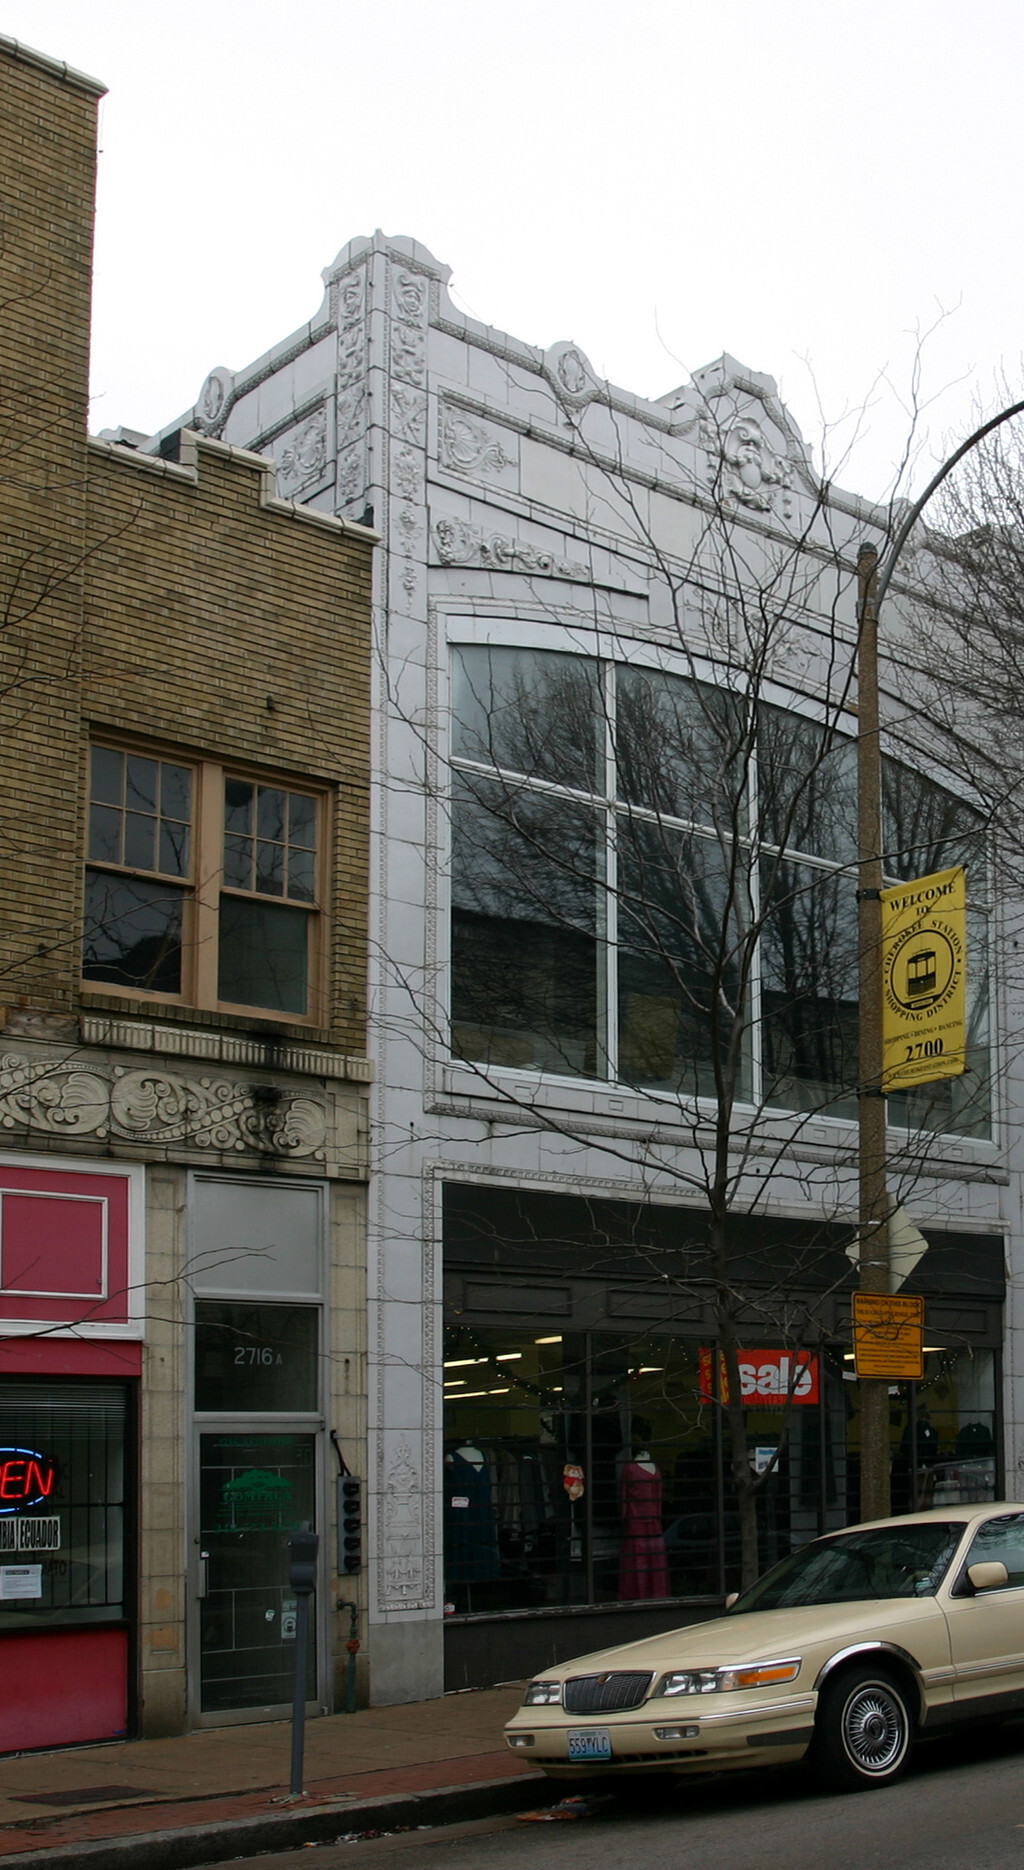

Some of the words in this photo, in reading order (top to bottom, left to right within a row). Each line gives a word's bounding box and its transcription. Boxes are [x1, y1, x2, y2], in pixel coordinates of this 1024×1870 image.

[889, 881, 956, 911] WELCOME
[916, 905, 929, 916] TO
[930, 919, 962, 954] STATION
[884, 988, 923, 1021] SHOPPING
[926, 971, 962, 1018] DISTRICT
[904, 1037, 944, 1061] 2700
[234, 1346, 273, 1365] 2716
[738, 1356, 812, 1396] sale
[0, 1458, 54, 1499] EN
[20, 1519, 59, 1549] ECUADOR
[569, 1737, 587, 1754] 559
